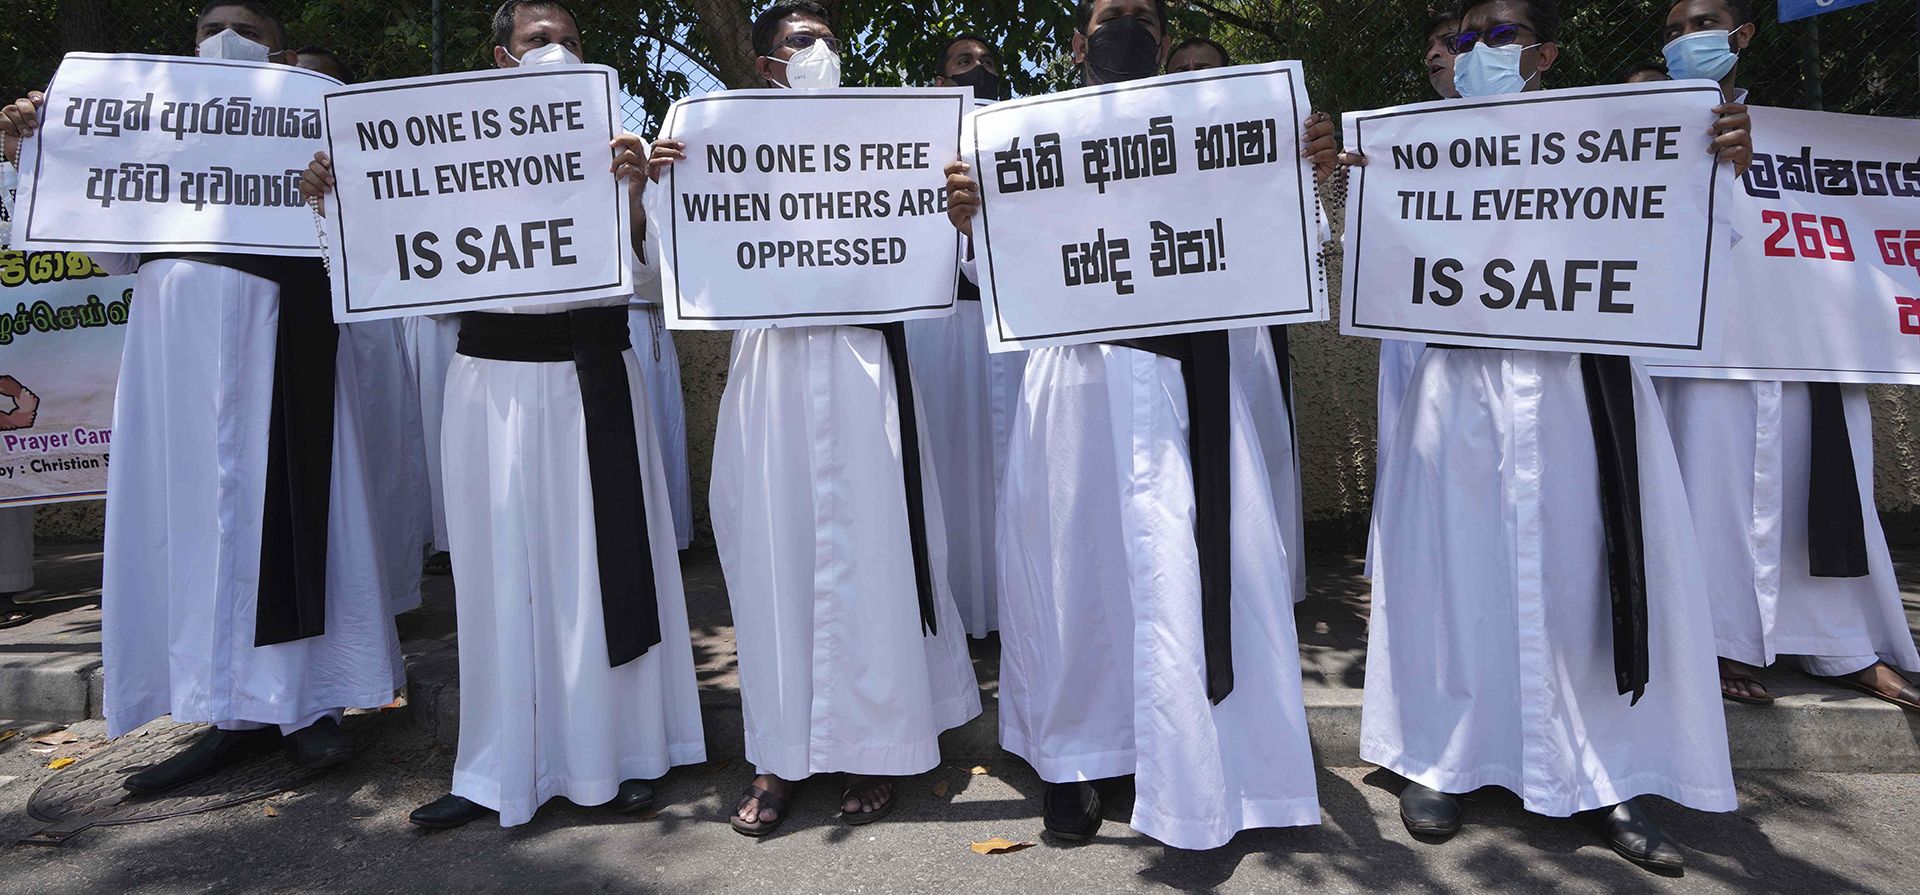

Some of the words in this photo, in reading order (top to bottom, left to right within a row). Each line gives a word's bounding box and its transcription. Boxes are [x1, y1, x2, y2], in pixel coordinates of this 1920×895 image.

[64, 92, 154, 138] අලුත්
[355, 119, 399, 152] NO
[405, 111, 467, 147] ONE
[471, 108, 502, 140] IS
[508, 100, 585, 136] SAFE
[706, 143, 747, 174] NO
[755, 143, 816, 173] ONE
[823, 143, 851, 172] IS
[860, 142, 930, 171] FREE
[994, 132, 1065, 194] ජාති
[1081, 115, 1178, 195] ආගම්
[1194, 118, 1278, 171] භාෂා
[1391, 141, 1439, 170] NO
[1448, 134, 1521, 169] ONE
[1530, 131, 1566, 165] IS
[1575, 125, 1682, 164] SAFE
[86, 162, 170, 208] අපිට
[366, 167, 430, 200] TILL
[434, 151, 585, 195] EVERYONE
[681, 192, 771, 222] WHEN
[779, 189, 891, 221] OTHERS
[897, 185, 949, 218] ARE
[1397, 190, 1463, 221] TILL
[1471, 185, 1667, 221] EVERYONE
[395, 231, 443, 281] IS
[455, 217, 578, 275] SAFE
[736, 237, 907, 270] OPPRESSED
[1061, 227, 1135, 296] භේද
[1149, 217, 1227, 278] එපා!
[1761, 209, 1856, 262] 269
[1411, 256, 1464, 307] IS
[1479, 258, 1638, 314] SAFE
[4, 431, 69, 453] Prayer
[30, 457, 100, 473] Christian
